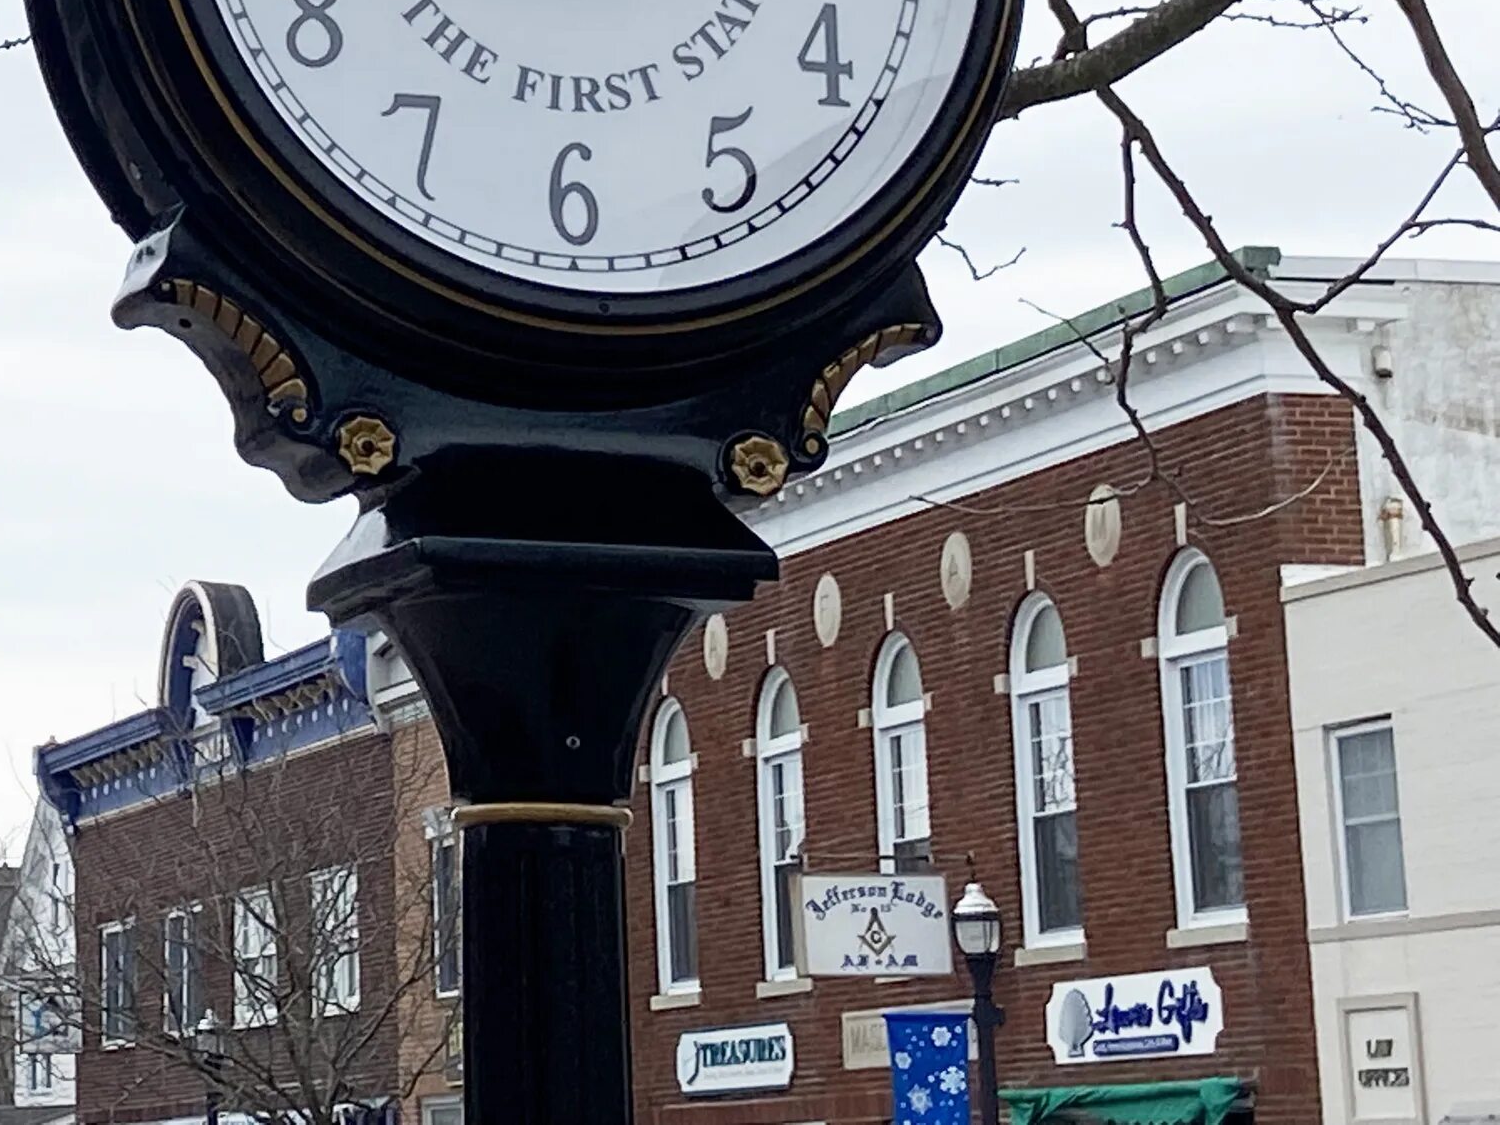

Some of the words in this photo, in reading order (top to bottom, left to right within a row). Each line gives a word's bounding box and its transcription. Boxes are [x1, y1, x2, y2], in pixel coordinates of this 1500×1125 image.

[512, 63, 662, 114] FIRST
[797, 3, 854, 107] 4
[381, 93, 441, 201] 7
[549, 142, 599, 246] 6
[701, 106, 756, 213] 5
[805, 885, 888, 921] Jefferson
[890, 881, 944, 919] Lodge
[1157, 978, 1209, 1044] Gifts
